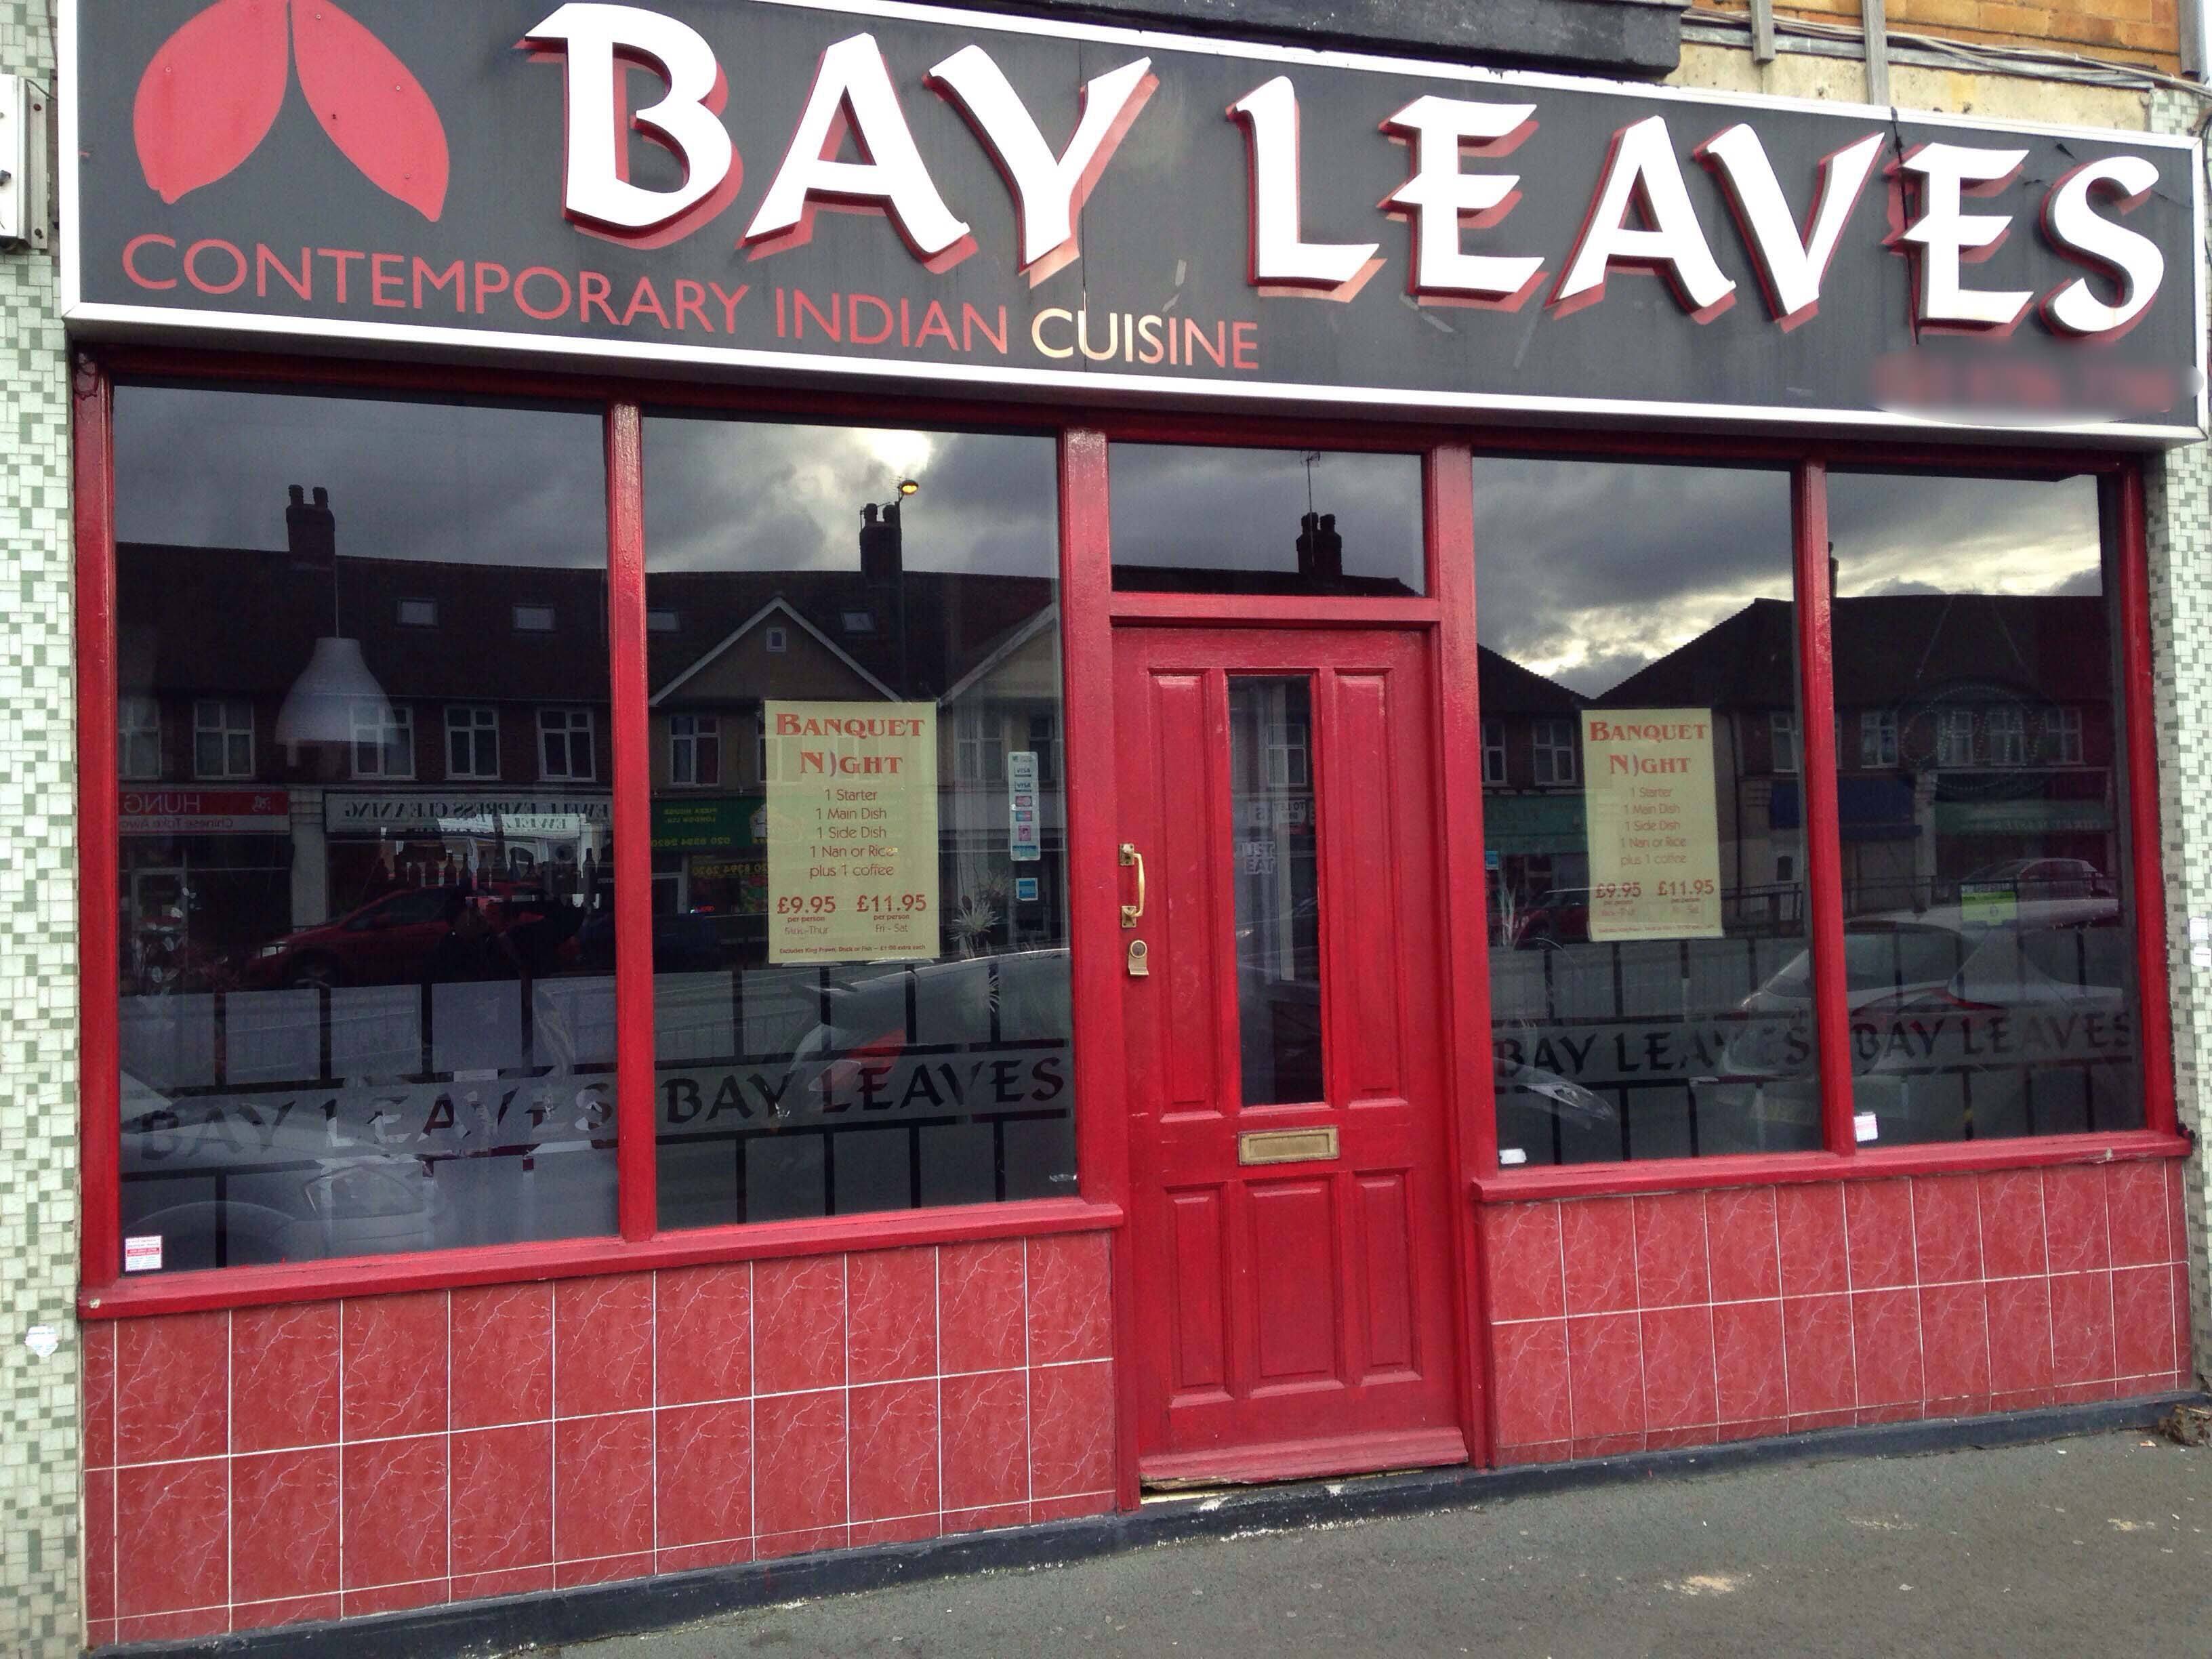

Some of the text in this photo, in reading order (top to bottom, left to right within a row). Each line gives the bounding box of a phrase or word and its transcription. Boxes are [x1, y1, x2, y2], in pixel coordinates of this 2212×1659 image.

[519, 2, 2166, 335] BAY LEAVES
[121, 234, 1259, 369] CONTEMPORARY INDIAN CUISINE
[776, 713, 925, 738] BANQUET
[1589, 720, 1708, 743] BANQUET
[824, 789, 877, 801] 1 Starter
[1639, 787, 1673, 798] Starter
[816, 807, 887, 819] 1 Main Dish
[1633, 804, 1656, 814] Main
[1659, 803, 1681, 814] Dish
[817, 826, 886, 838] 1 Side Dish
[1633, 822, 1656, 832] Side
[1659, 821, 1681, 831] Dish
[810, 844, 894, 857] 1 Nan or Rice
[1244, 857, 1275, 874] EAT
[1620, 857, 1641, 867] plus
[809, 864, 894, 880] plus 1 coffee
[1594, 879, 1715, 899] £9.95 £11.95
[777, 894, 927, 914] £9.95 £11.95
[886, 913, 910, 921] person
[875, 924, 885, 933] Fri
[894, 924, 909, 933] Sat
[1851, 1017, 1945, 1061] BAY
[1492, 1031, 1597, 1079] BAY
[661, 1056, 1066, 1124] BAY LEAVES
